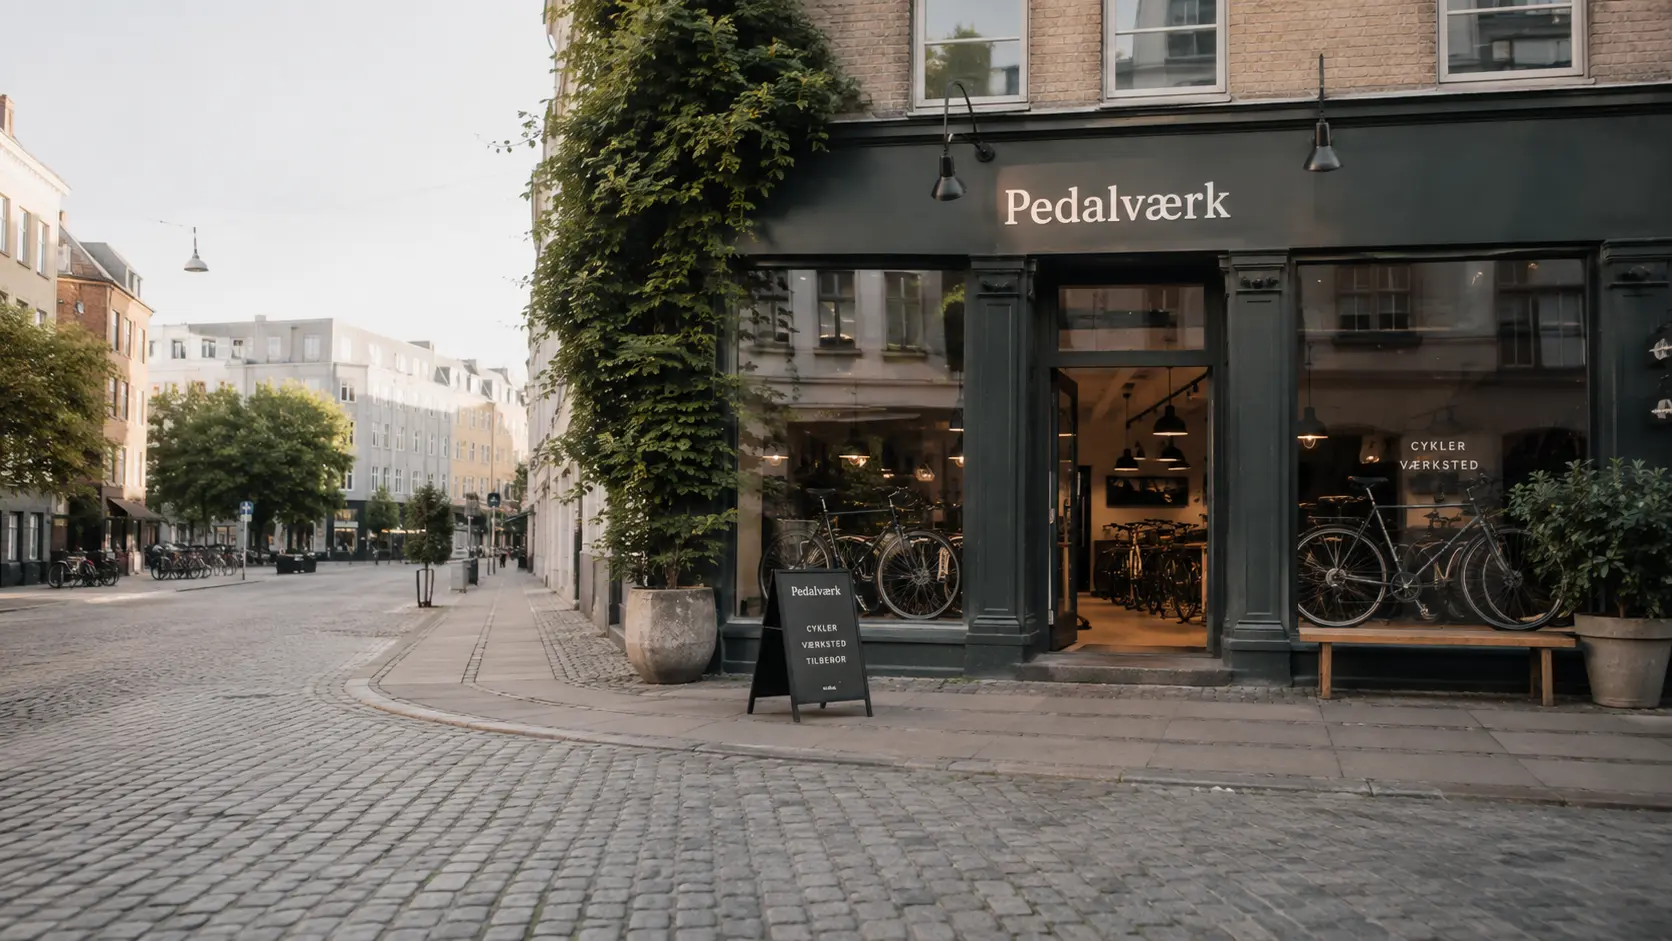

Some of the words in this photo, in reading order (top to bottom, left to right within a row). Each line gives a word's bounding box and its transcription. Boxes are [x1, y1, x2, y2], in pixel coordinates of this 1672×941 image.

[1004, 181, 1231, 225] Pedalværk
[1410, 440, 1465, 451] CYKLER
[1399, 459, 1479, 470] VÆRKSTED
[791, 585, 842, 597] Pedalværk
[806, 624, 837, 633] CYKLER
[802, 640, 846, 649] VÆRKSTED
